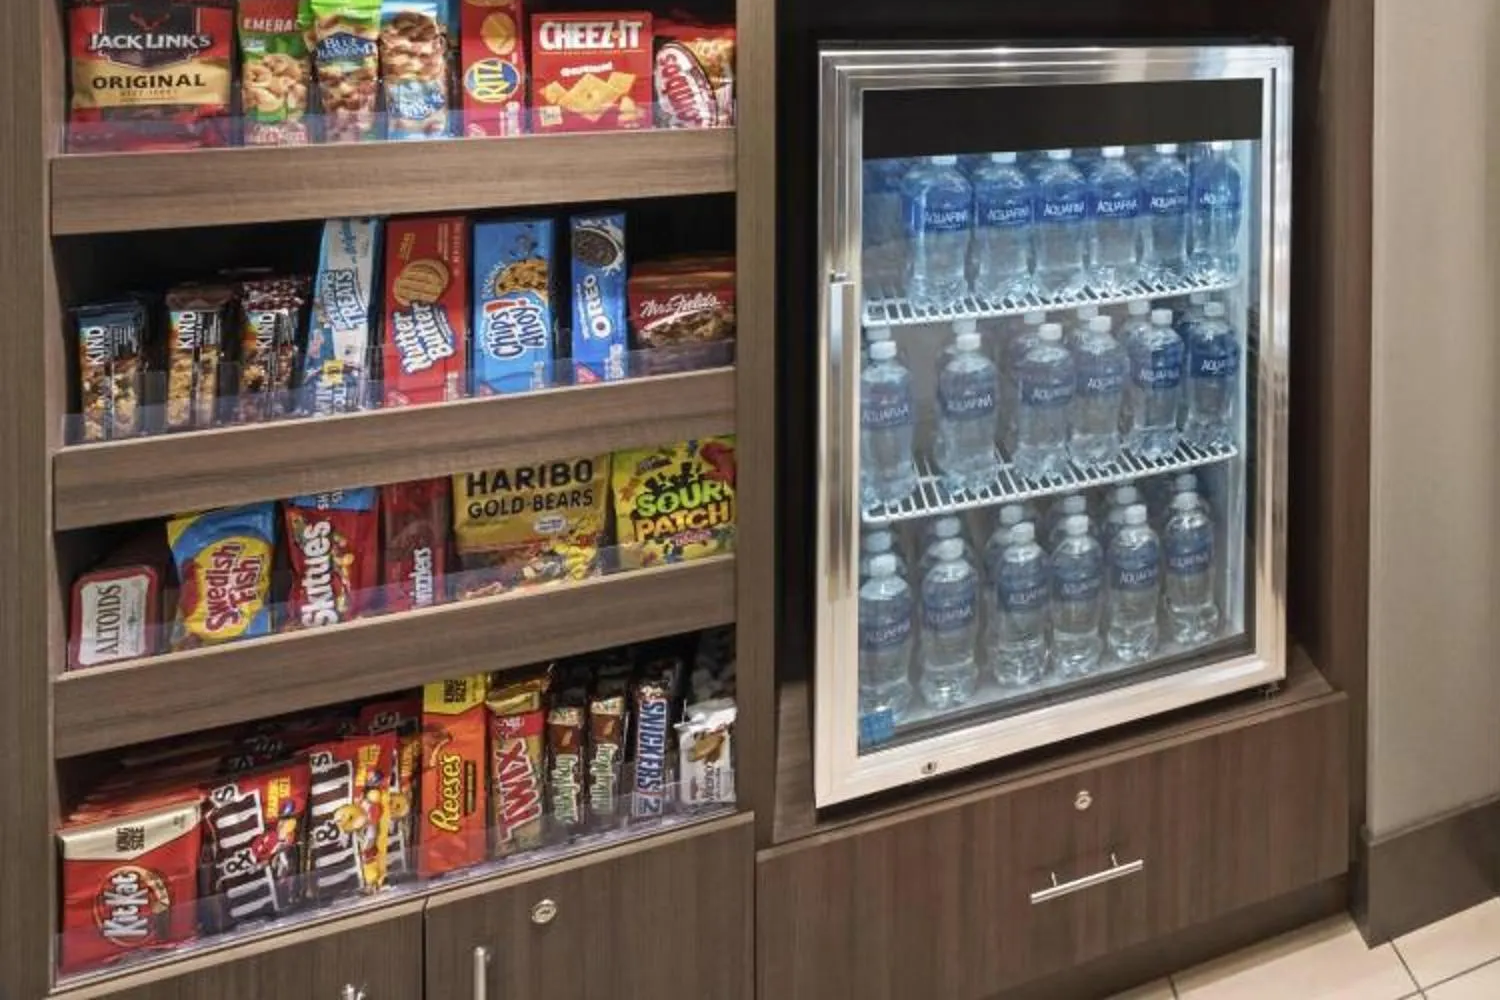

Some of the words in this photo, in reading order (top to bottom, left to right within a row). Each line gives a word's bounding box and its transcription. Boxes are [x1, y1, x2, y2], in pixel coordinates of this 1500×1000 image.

[90, 32, 144, 50] JACK
[92, 73, 207, 90] ORIGINAL
[474, 60, 511, 99] RITZ
[336, 270, 367, 328] TREATS
[584, 274, 612, 339] OREO
[86, 326, 105, 366] KIND
[176, 311, 197, 350] KIND
[255, 312, 276, 350] KIND
[393, 312, 432, 373] Nutter
[411, 302, 454, 360] Butter
[490, 311, 524, 358] Chips
[466, 459, 593, 497] HARIBO
[637, 478, 720, 518] SOUR
[634, 500, 731, 543] PATCH
[205, 542, 243, 632] Swedish
[230, 554, 263, 608] Fish
[95, 584, 122, 655] ALTOIDS
[638, 701, 666, 791] SNICKERS
[498, 737, 543, 843] TWIX
